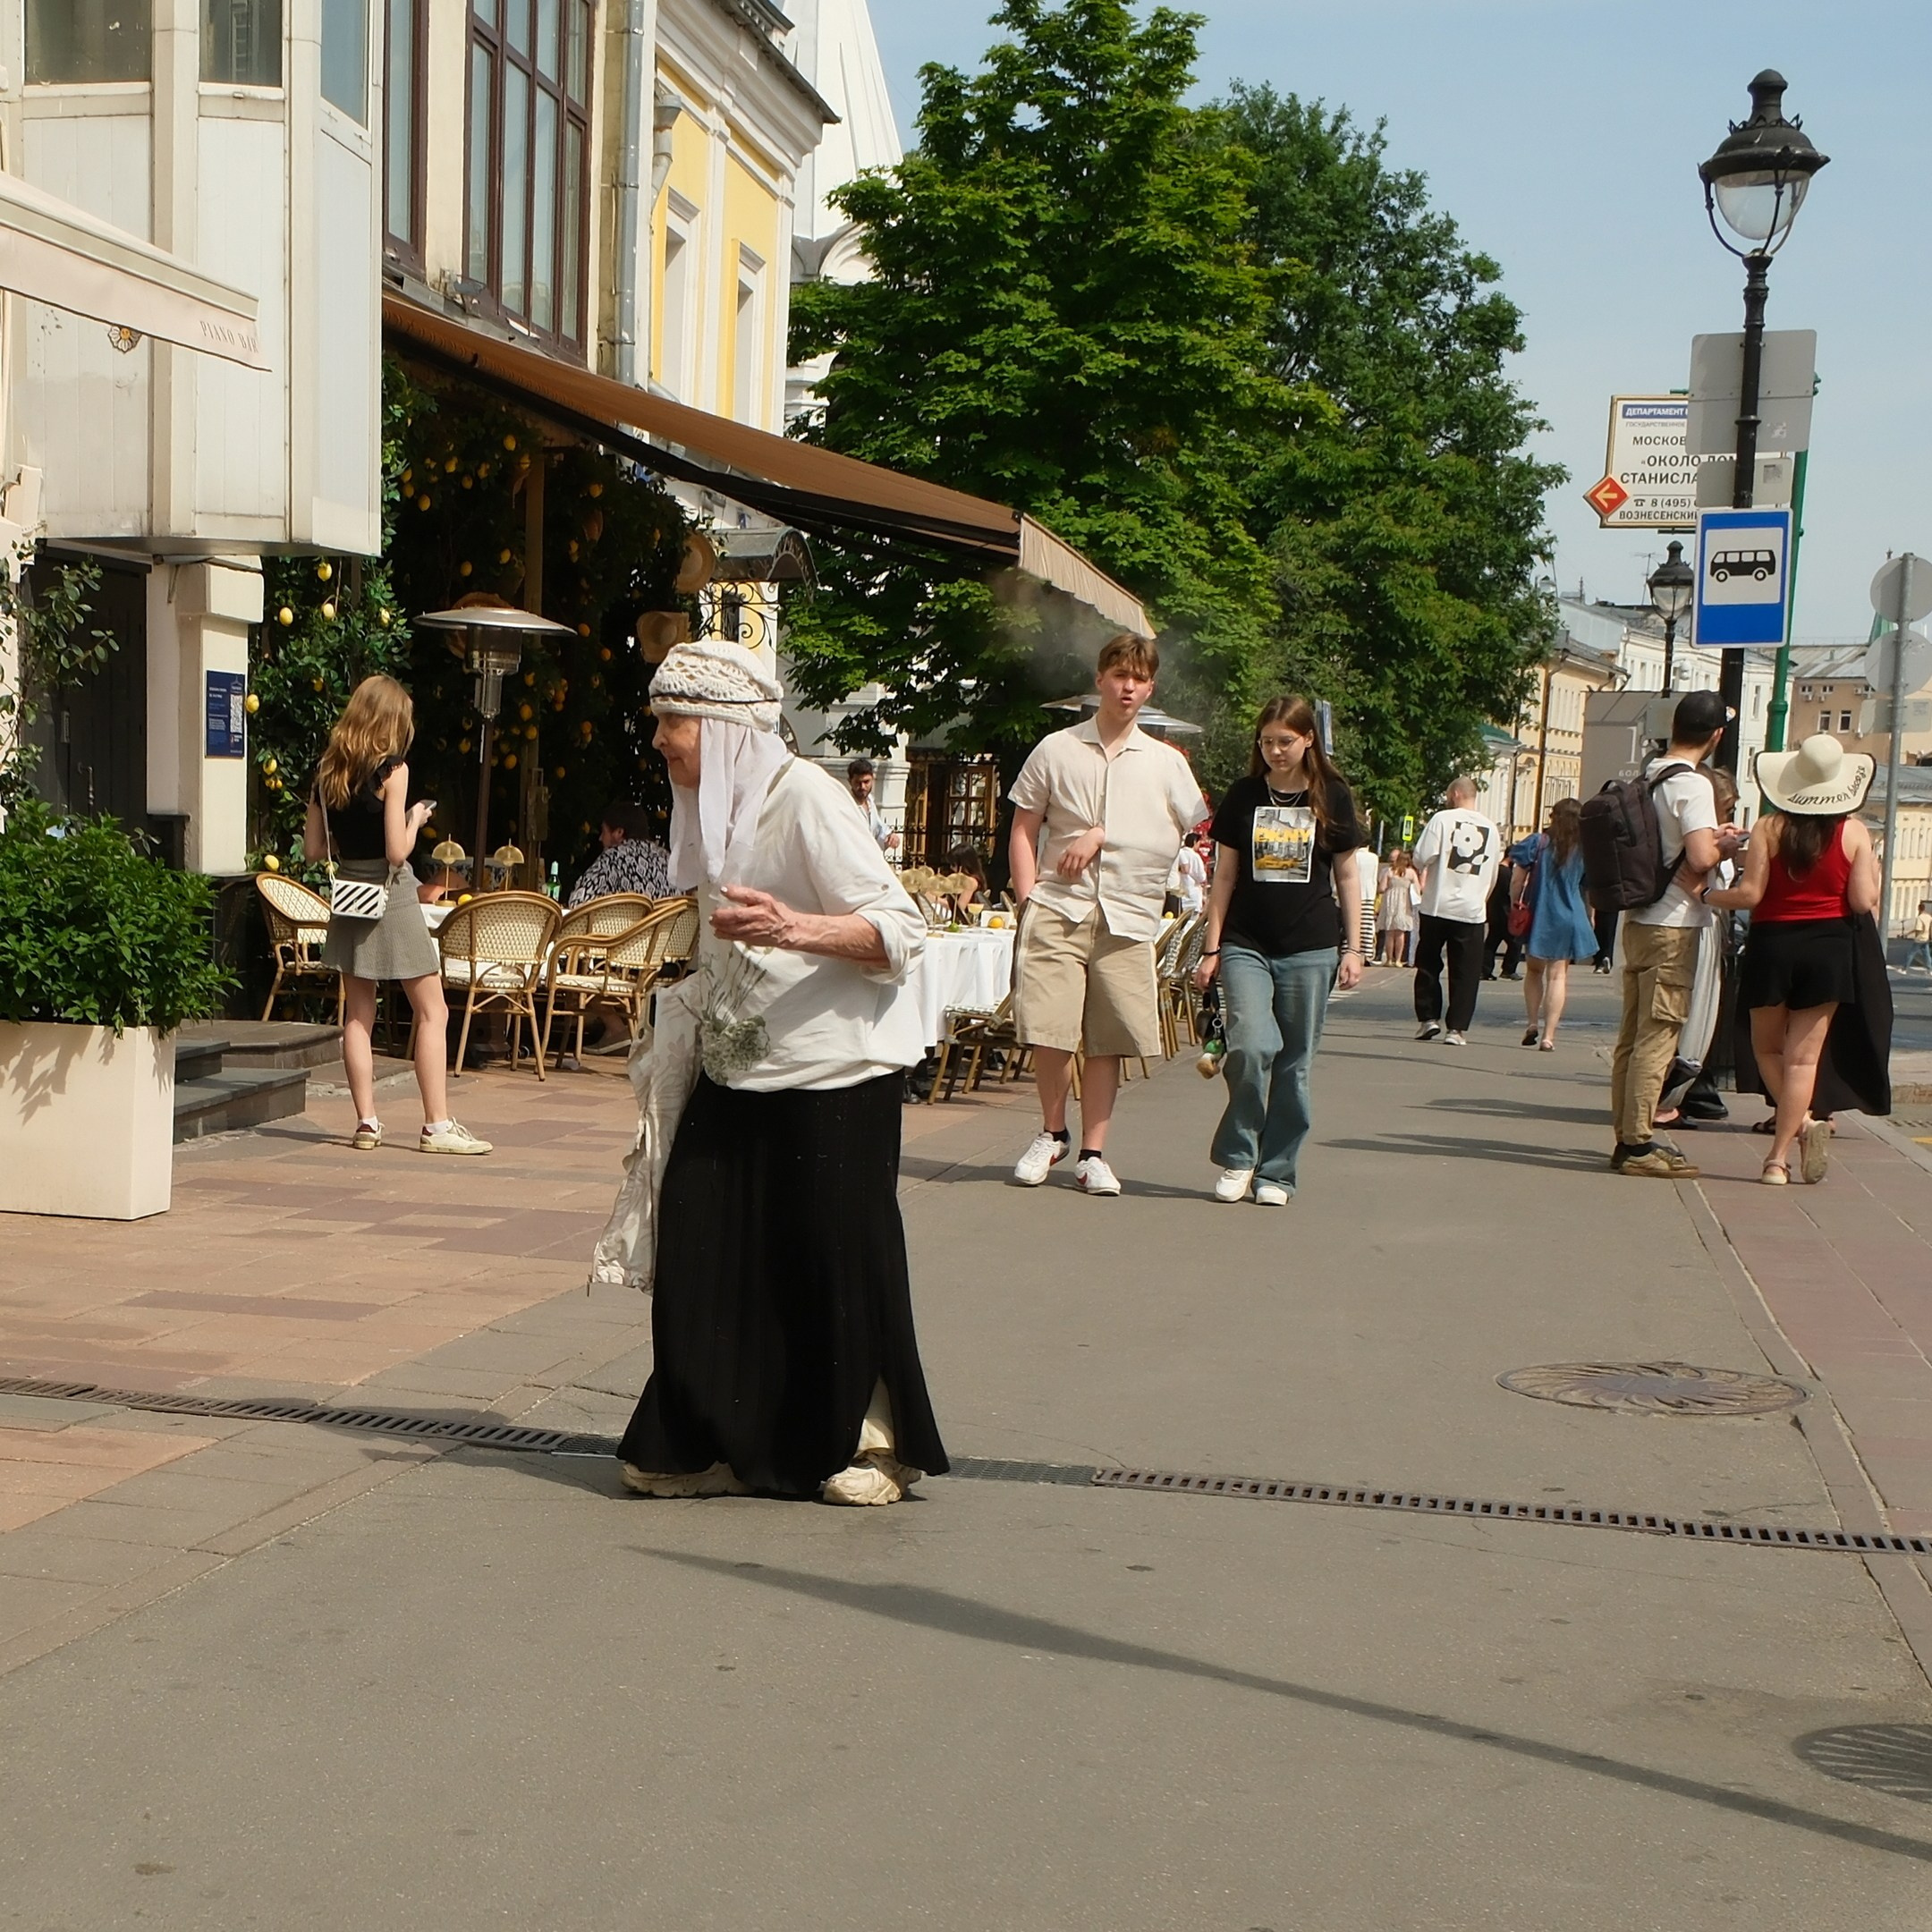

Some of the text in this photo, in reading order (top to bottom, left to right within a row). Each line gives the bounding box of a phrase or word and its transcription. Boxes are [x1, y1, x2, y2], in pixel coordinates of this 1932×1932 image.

[1625, 406, 1684, 417] ДЕПАРТАМЕНТ
[1650, 498, 1657, 506] 8
[1660, 498, 1691, 507] (495)
[1786, 792, 1851, 805] summer
